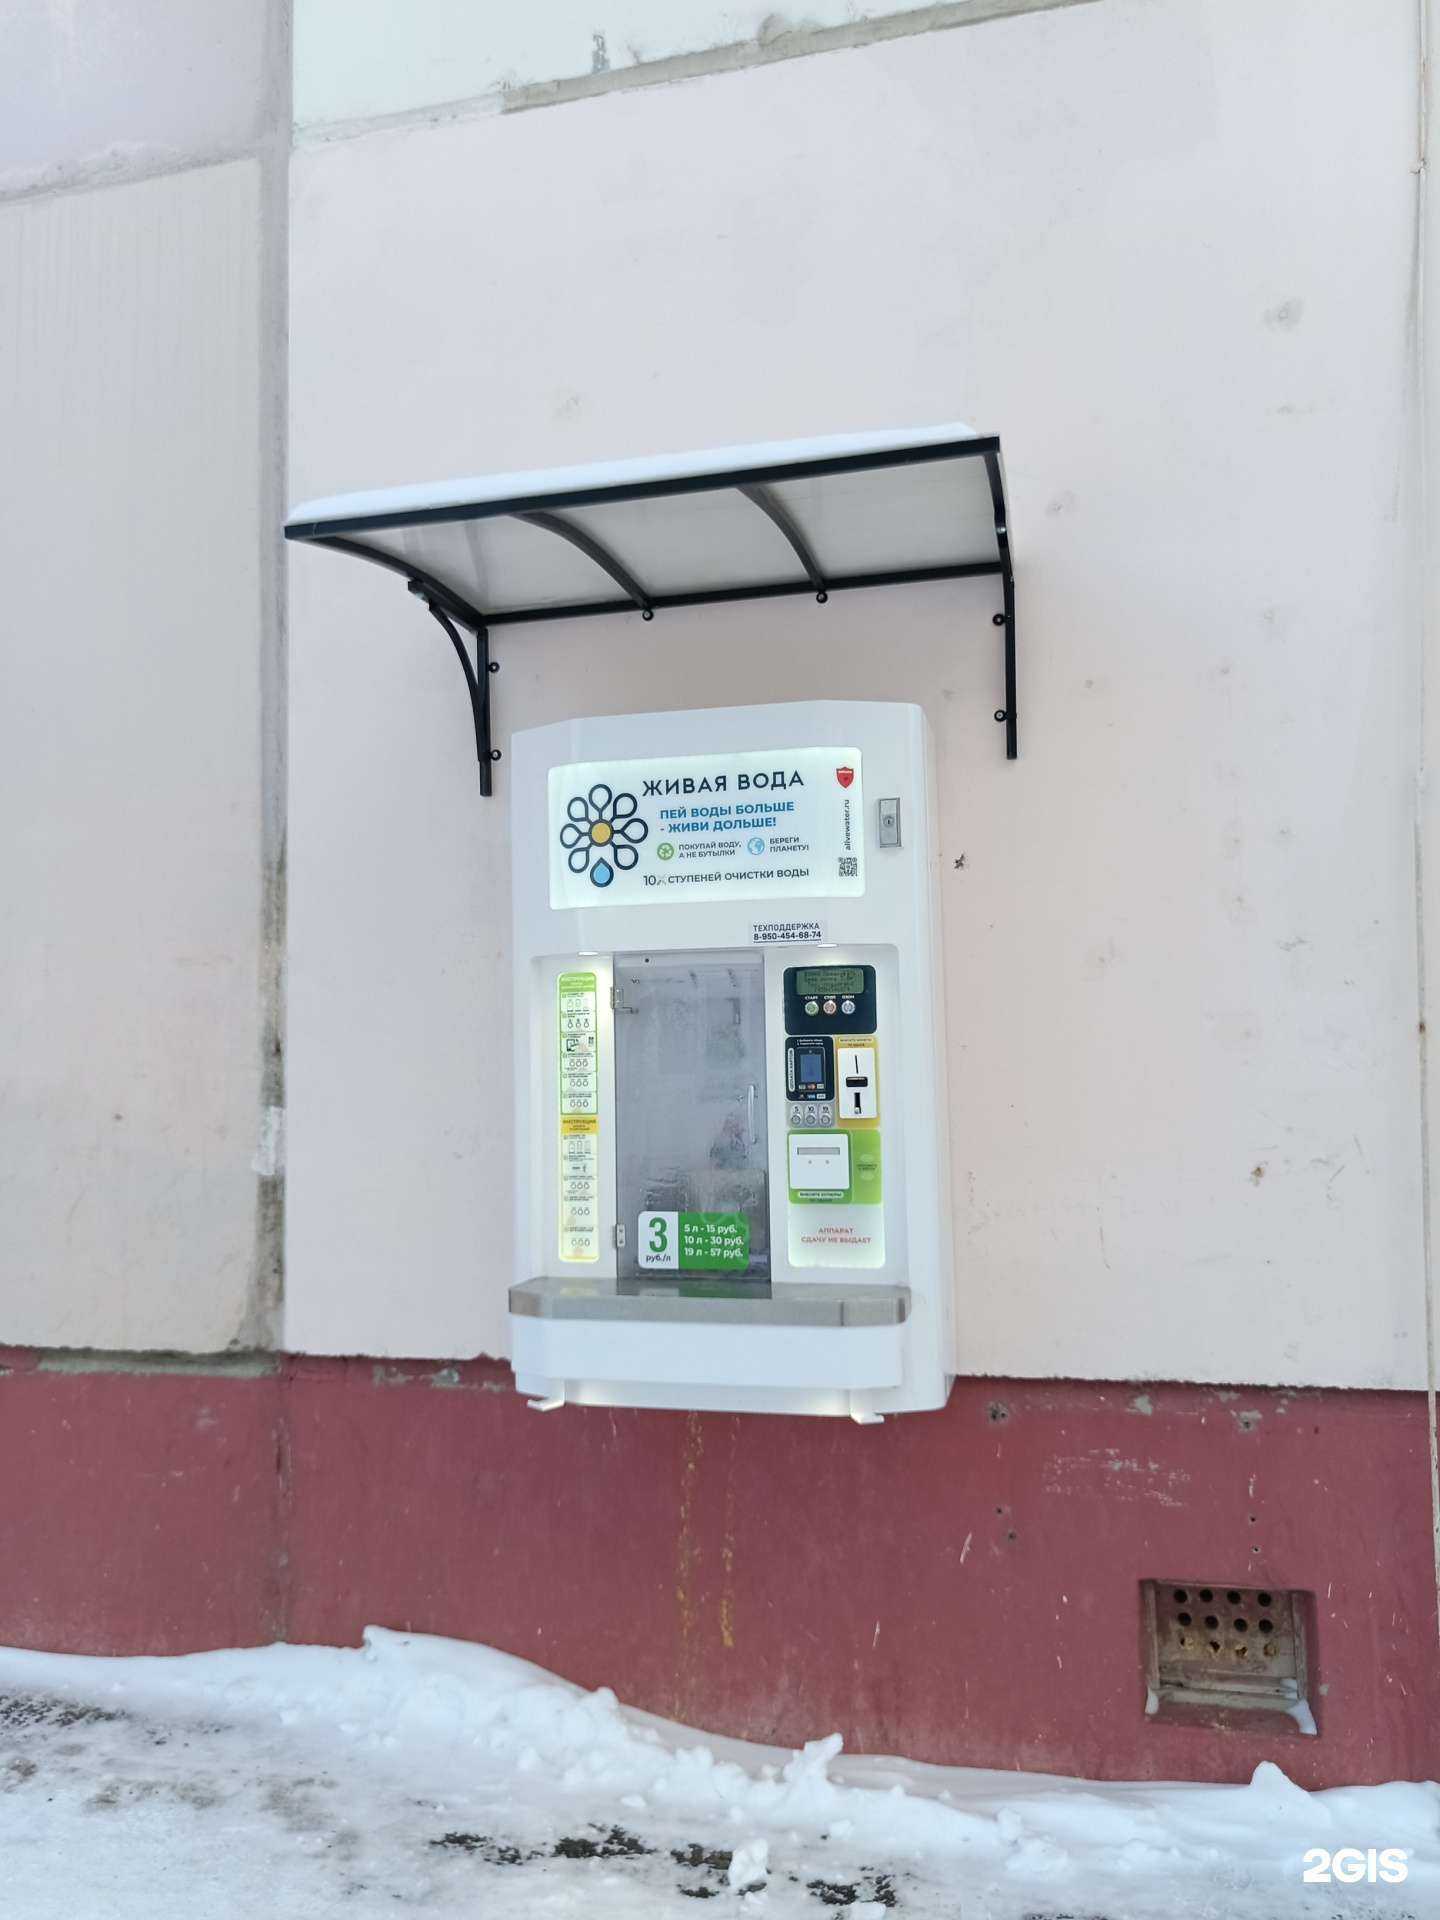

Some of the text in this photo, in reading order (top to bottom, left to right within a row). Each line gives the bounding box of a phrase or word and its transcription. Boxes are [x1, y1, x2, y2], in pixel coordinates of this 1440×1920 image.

[642, 770, 804, 797] ЖИВАЯ ВОДА
[660, 801, 794, 819] ПЕЙ ВОДЫ БОЛЬШЕ
[668, 820, 709, 833] ЖИВИ
[713, 817, 776, 832] ДОЛЬШЕ!
[770, 836, 799, 844] БЕРЕГИ
[679, 842, 716, 850] ПОКУПАЙ
[770, 844, 809, 852] ПЛАНЕТУ!
[698, 849, 736, 857] БУТЫЛКИ
[668, 872, 721, 884] СТУПЕНЕЙ
[724, 870, 775, 881] ОЧИСТКИ
[777, 868, 809, 879] ВОДЫ
[753, 923, 819, 932] ТЕХПОДДЕРЖКА
[718, 1224, 737, 1234] руб.
[649, 1217, 668, 1253] 3
[685, 1236, 694, 1244] 10
[710, 1236, 722, 1244] 30
[724, 1236, 744, 1246] руб.
[646, 1254, 671, 1262] руб./л
[685, 1248, 694, 1256] 19
[710, 1248, 721, 1256] 57
[724, 1248, 743, 1258] руб.
